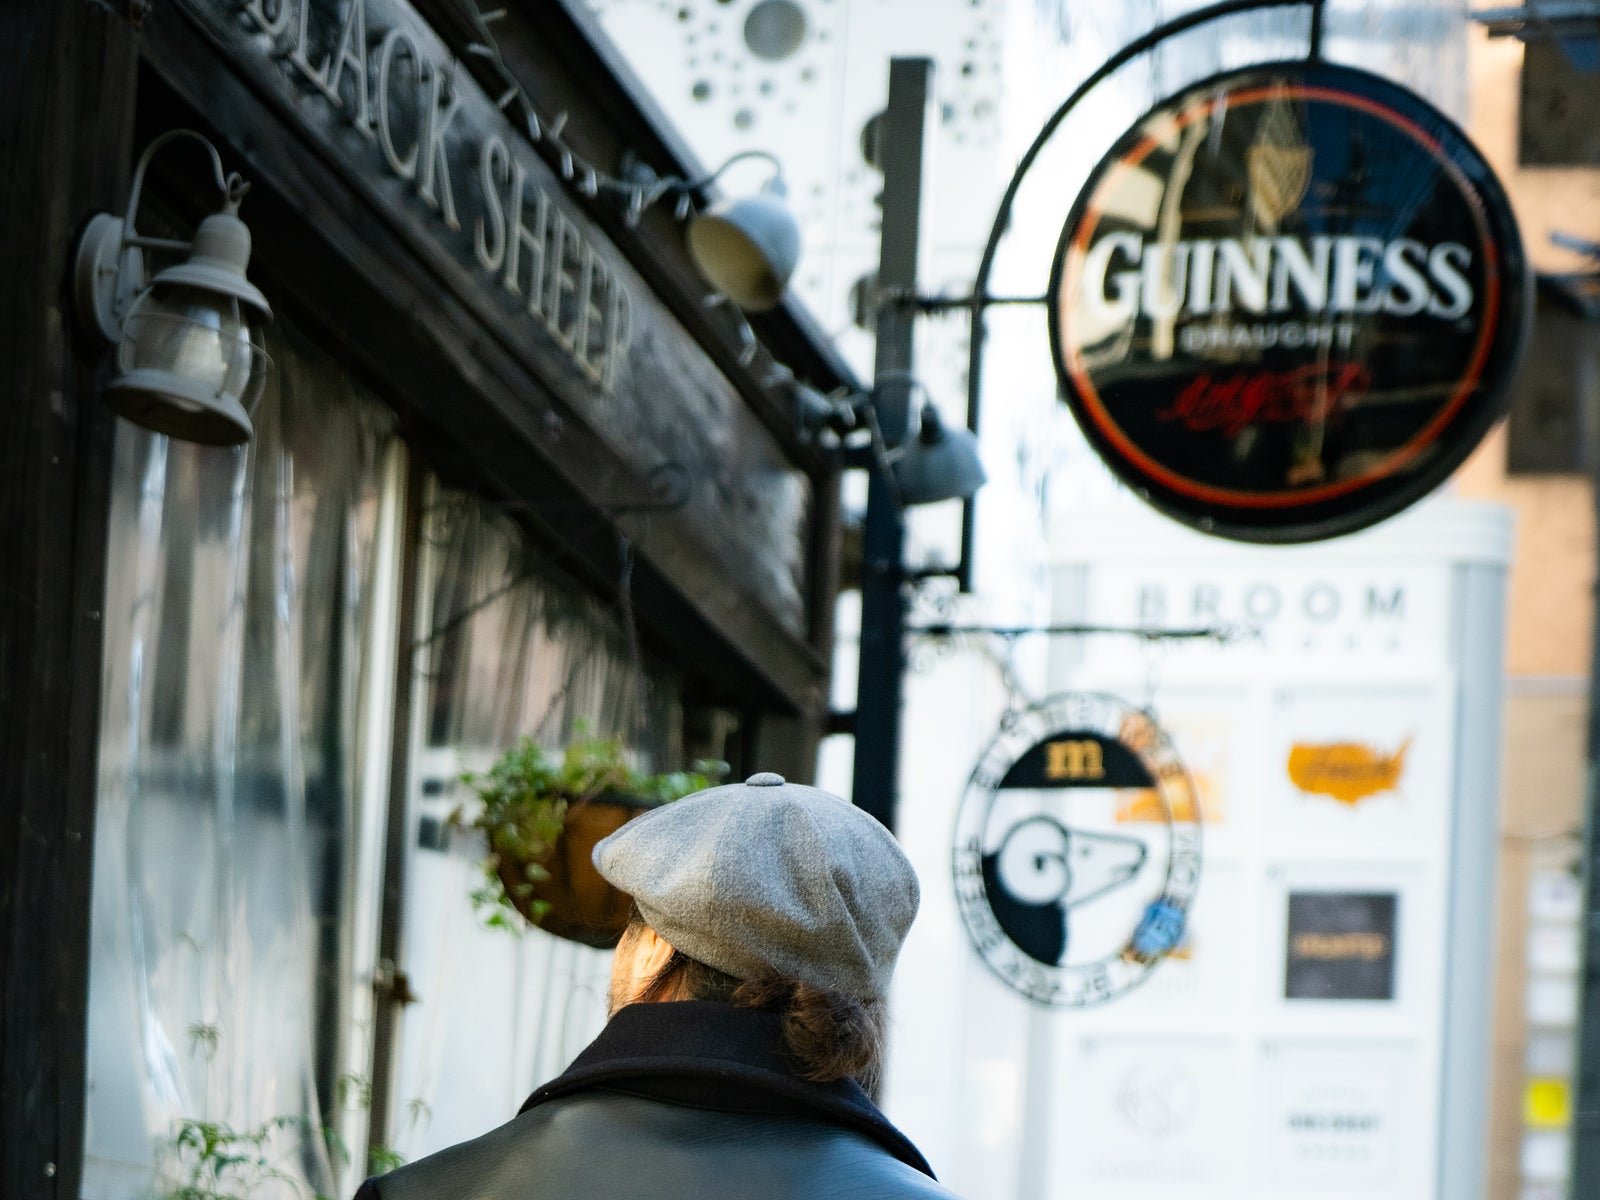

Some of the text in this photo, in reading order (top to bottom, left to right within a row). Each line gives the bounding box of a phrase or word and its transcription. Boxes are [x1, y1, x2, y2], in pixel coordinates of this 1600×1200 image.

[244, 0, 632, 393] LACK SHEEP
[1082, 231, 1473, 320] GUINNESS
[1182, 325, 1356, 351] DRAUGHT
[1138, 580, 1407, 624] BROOM
